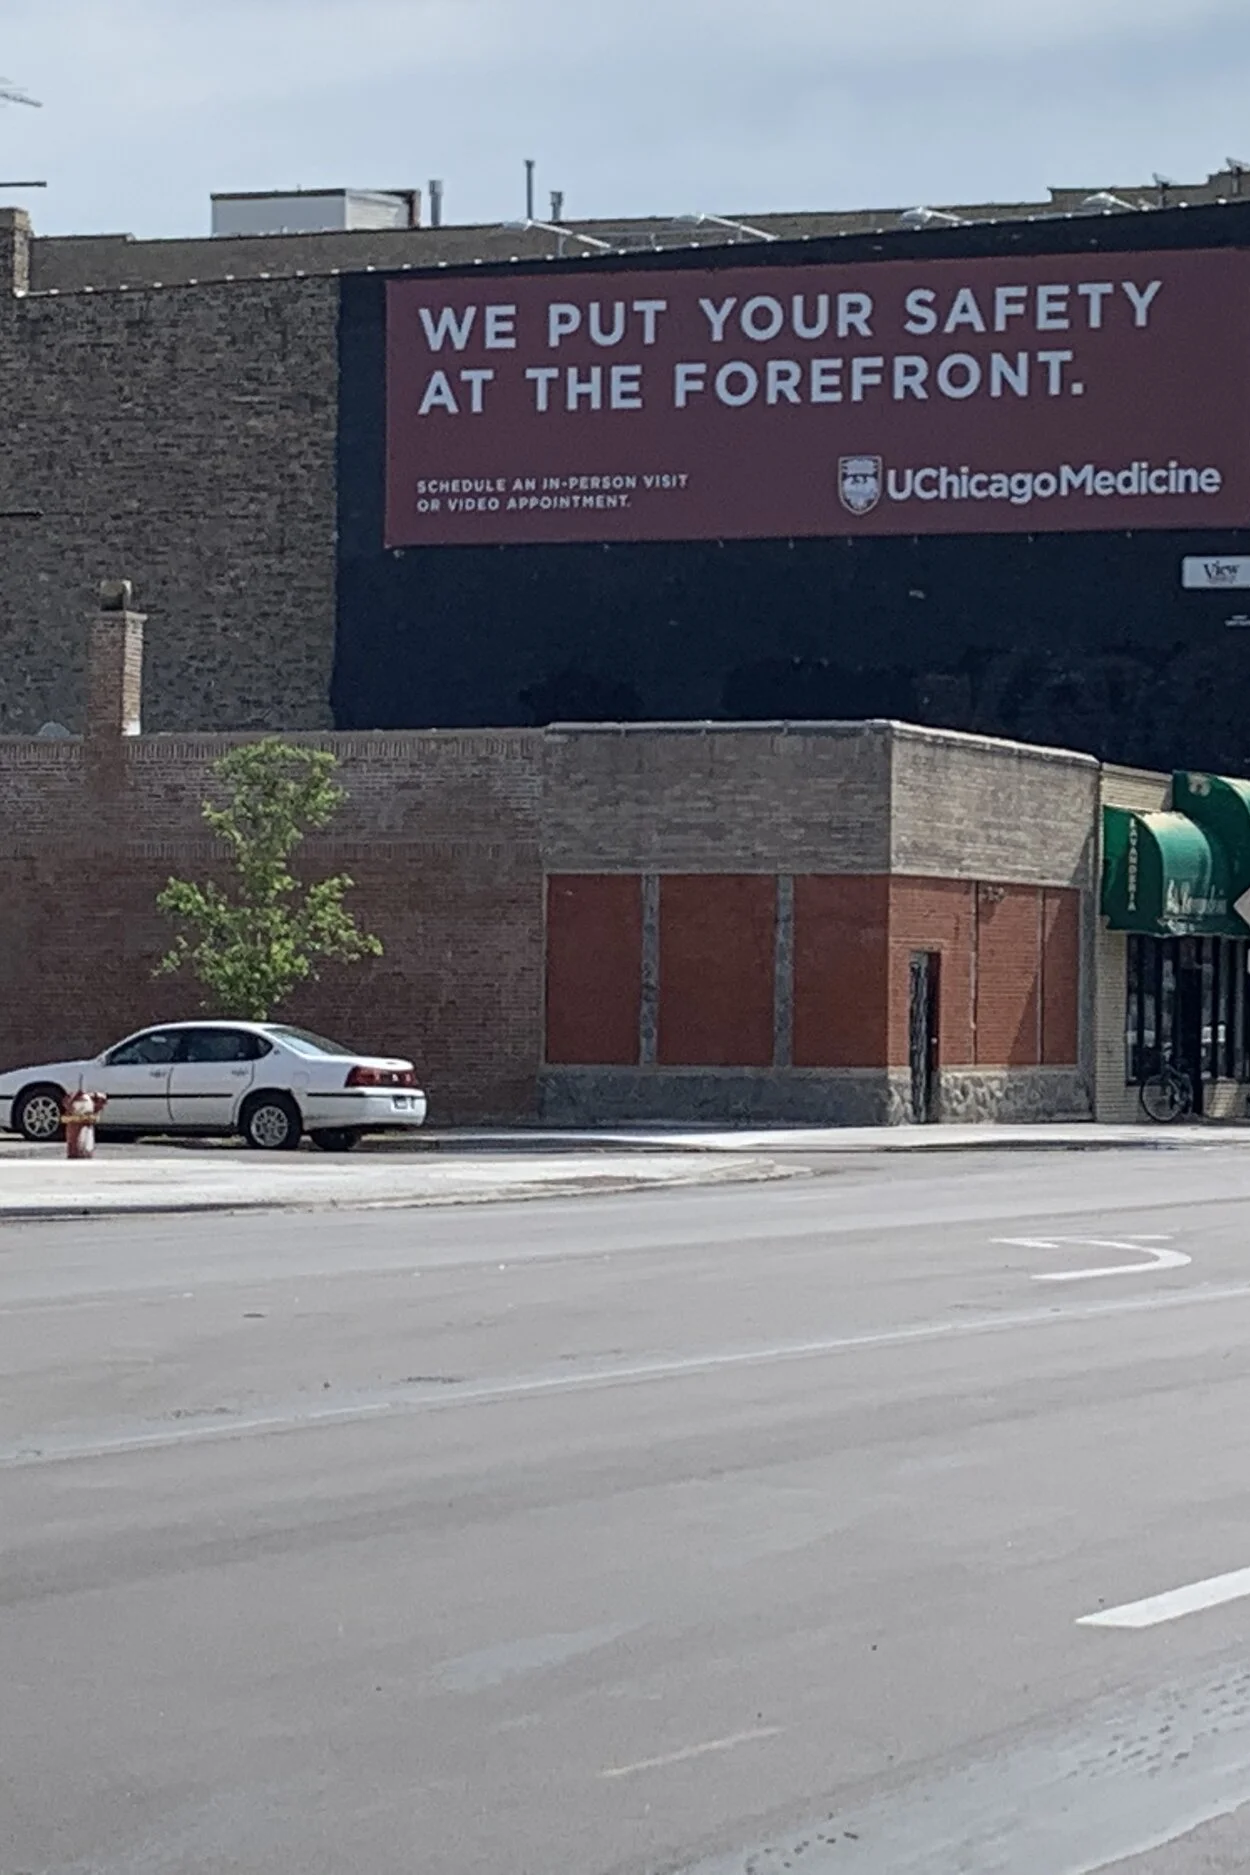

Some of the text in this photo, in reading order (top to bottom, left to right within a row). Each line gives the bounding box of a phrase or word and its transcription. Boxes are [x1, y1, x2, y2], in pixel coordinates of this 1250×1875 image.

[418, 280, 1163, 352] WE PUT YOUR SAFETY
[417, 350, 1084, 415] AT THE FOREFRONT.
[416, 473, 690, 495] SCHEDULE AN IN-PERSON VISIT
[416, 494, 631, 513] OR VIDEO APPOINTMENT.
[887, 461, 1222, 505] UChicagoMedicine
